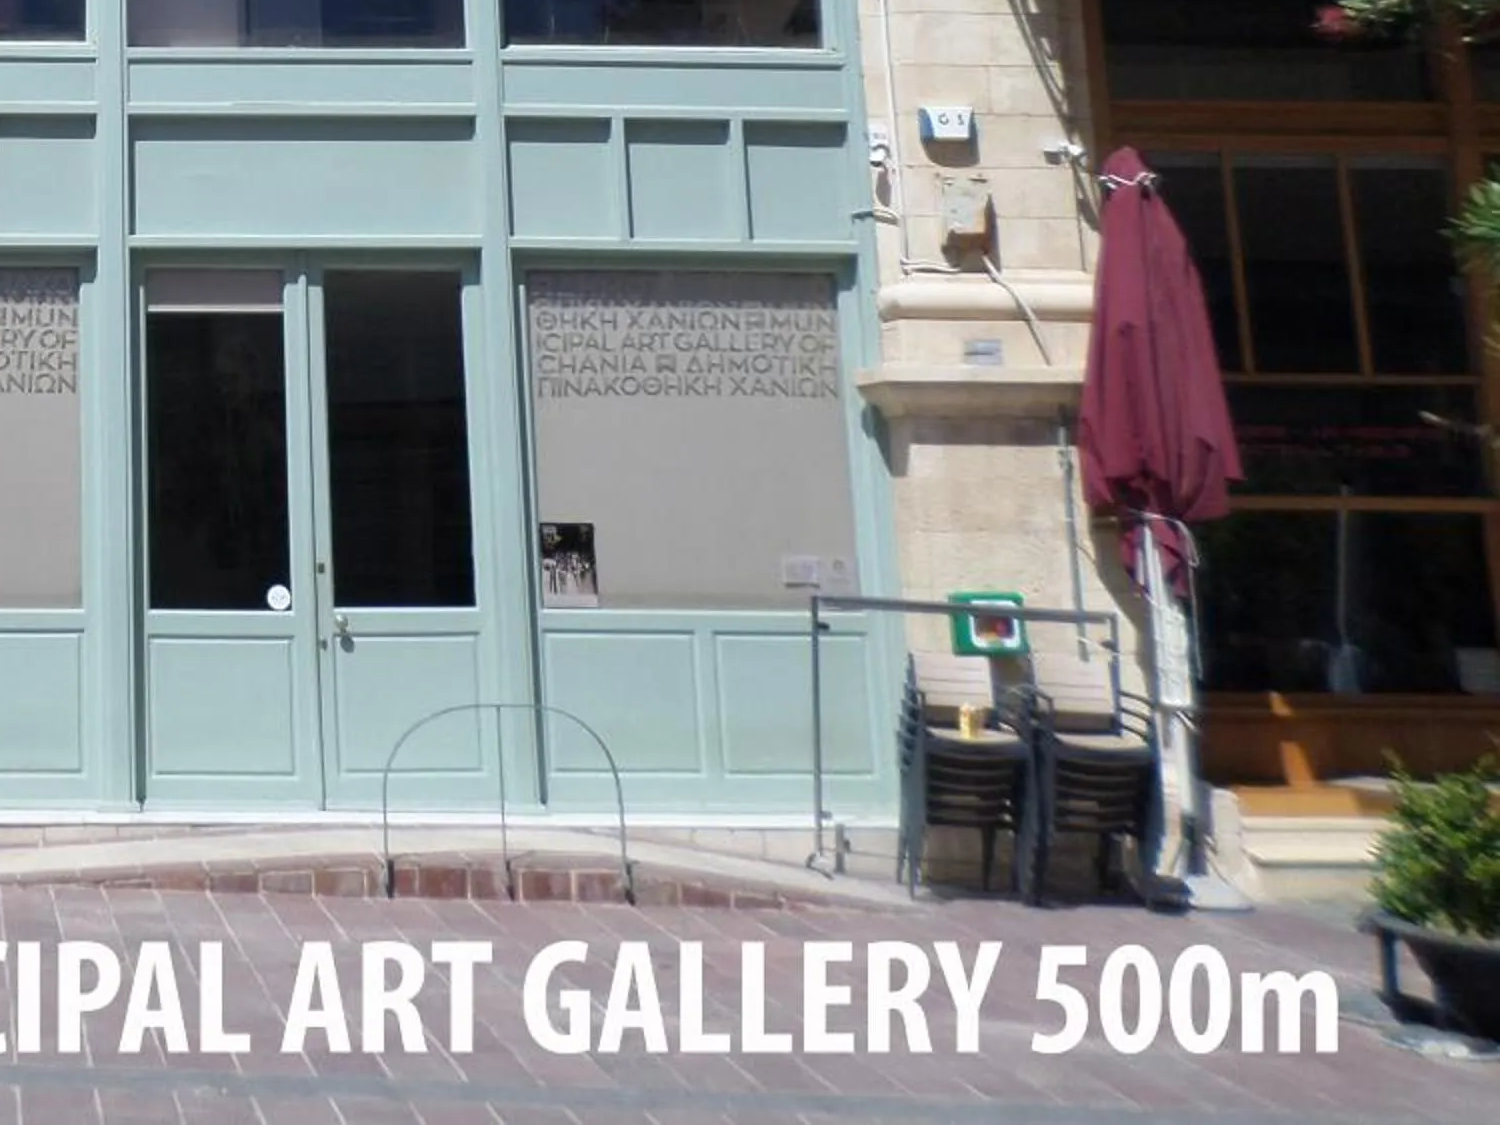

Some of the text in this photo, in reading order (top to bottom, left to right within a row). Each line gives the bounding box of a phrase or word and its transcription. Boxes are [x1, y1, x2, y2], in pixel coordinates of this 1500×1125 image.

[39, 328, 77, 349] OF
[621, 332, 673, 353] ART
[673, 332, 795, 354] GALLERY
[799, 333, 835, 354] OF
[537, 354, 647, 375] CHANIA
